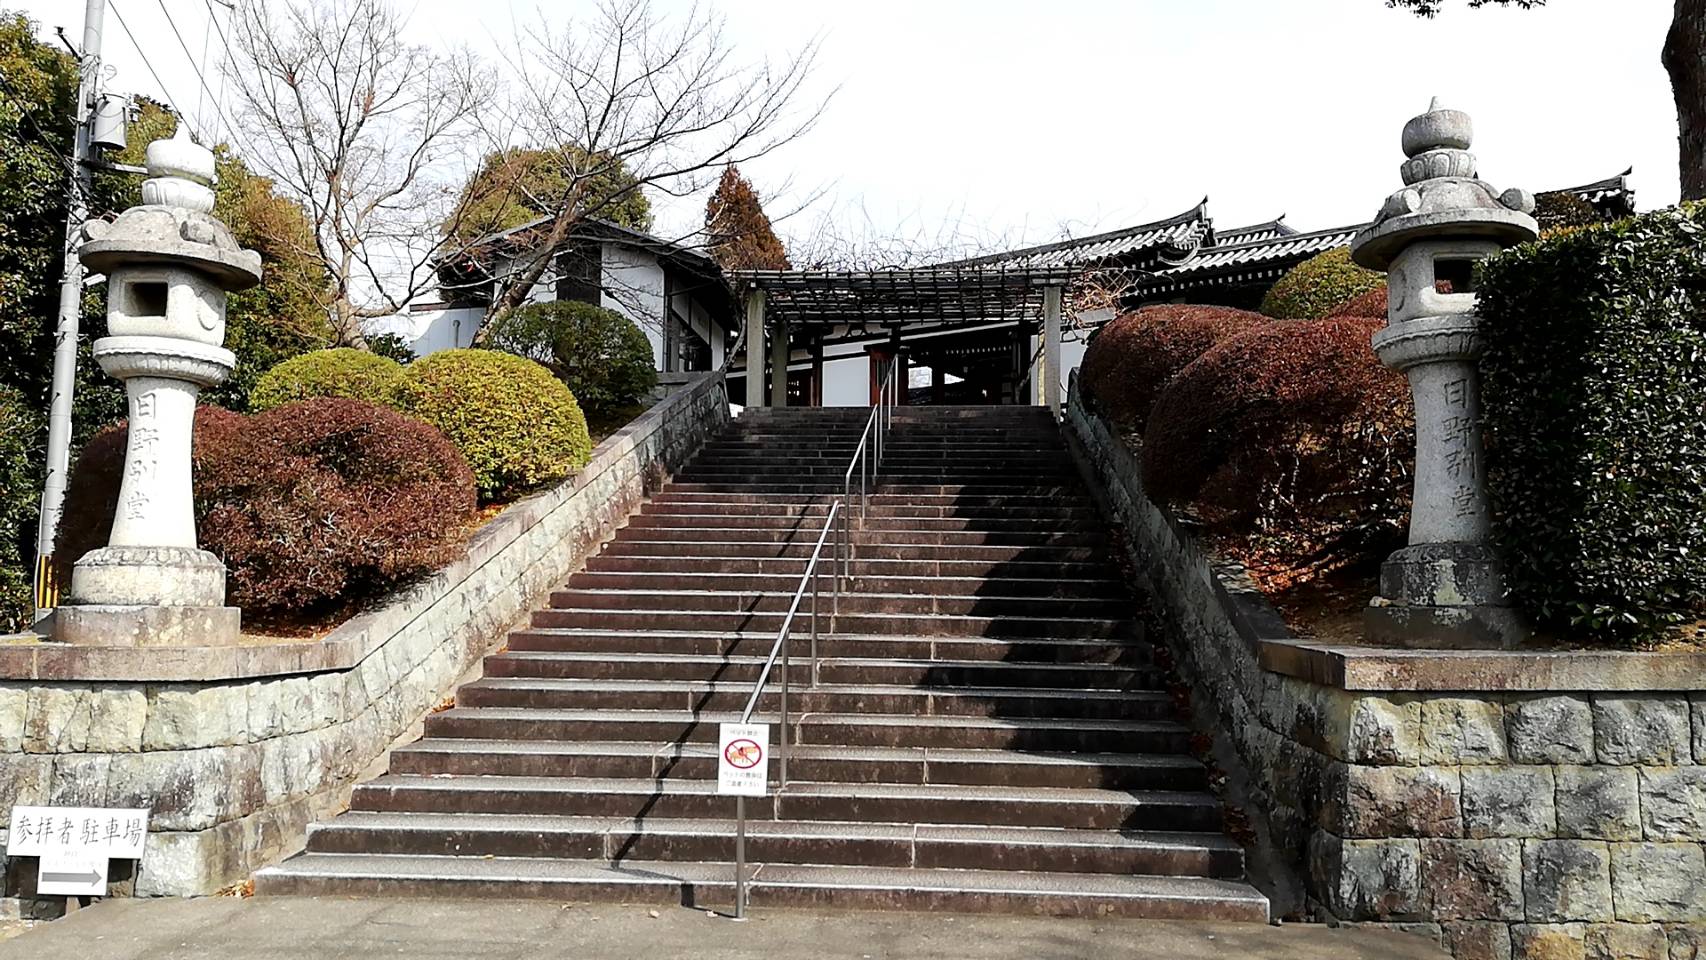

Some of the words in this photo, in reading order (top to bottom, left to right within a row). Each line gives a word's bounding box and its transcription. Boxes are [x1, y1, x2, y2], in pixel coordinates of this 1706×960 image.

[17, 815, 142, 847] 参拝者駐車場
